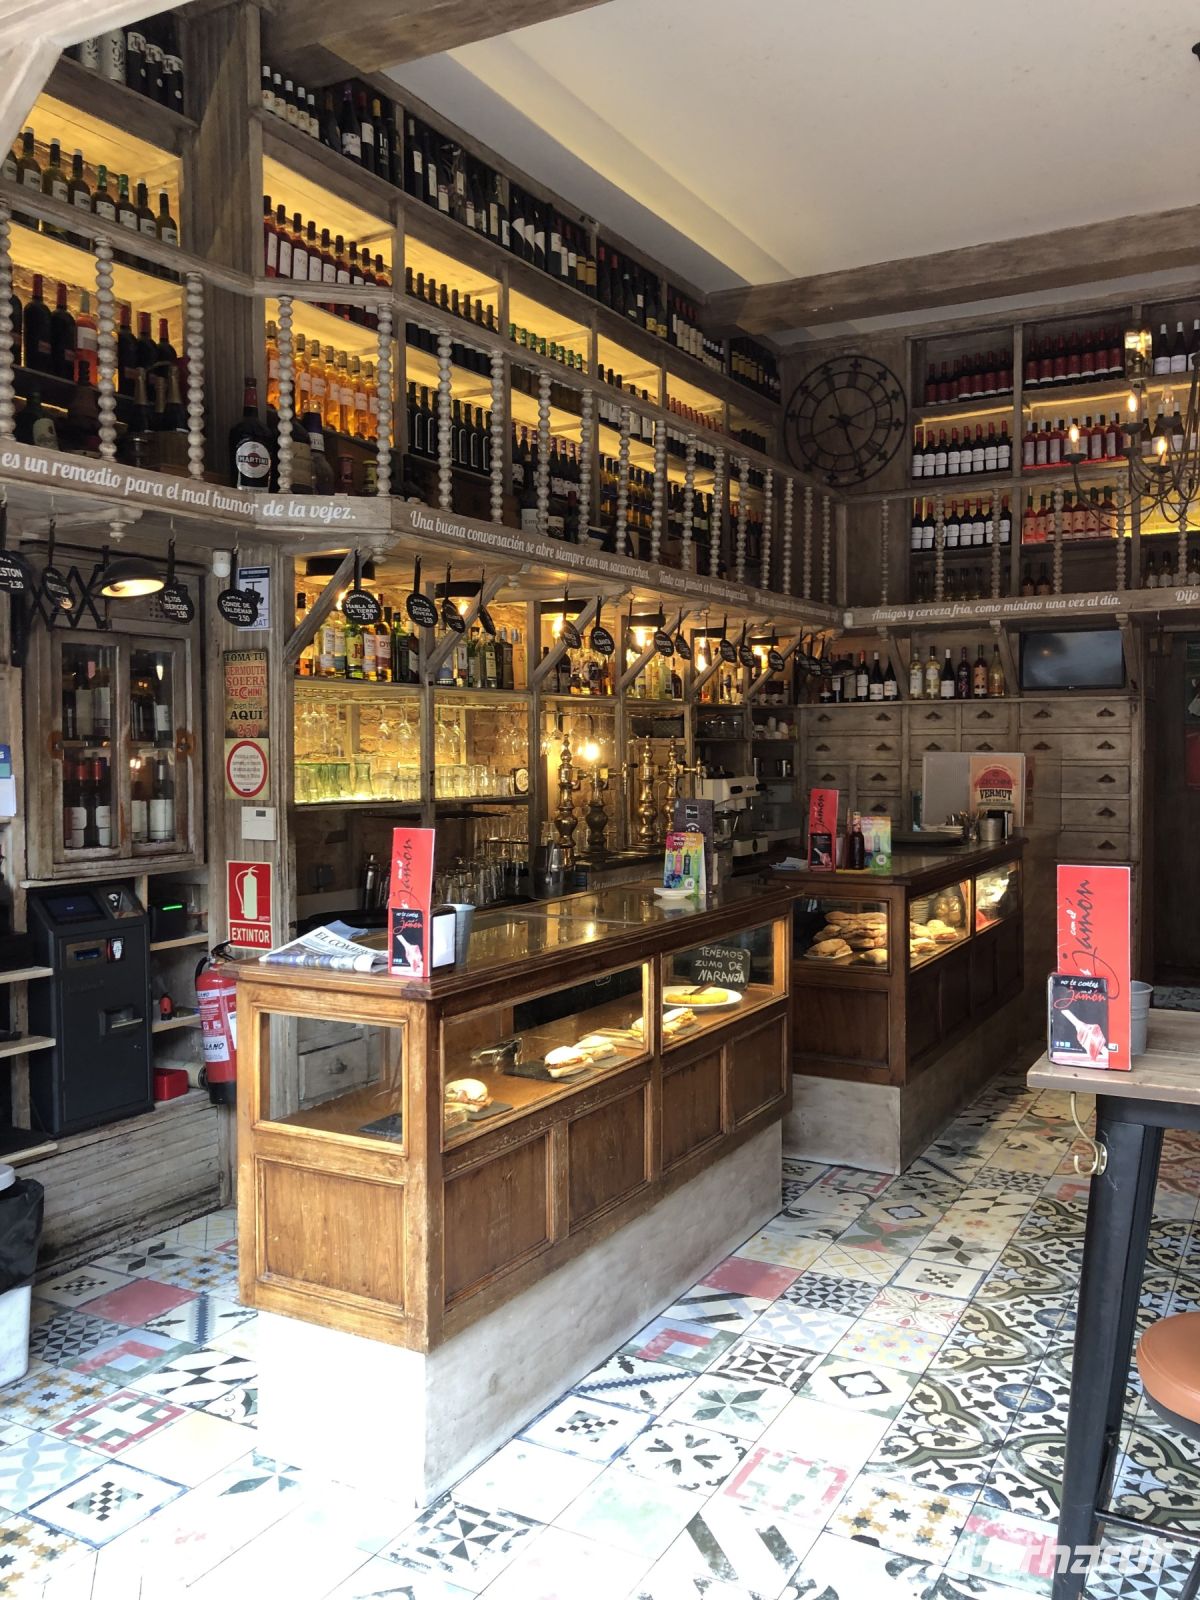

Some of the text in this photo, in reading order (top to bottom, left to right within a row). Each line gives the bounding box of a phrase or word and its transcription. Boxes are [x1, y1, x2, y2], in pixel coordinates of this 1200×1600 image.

[237, 455, 268, 465] MARTINI
[2, 452, 356, 523] es un remedio para el mal humor de la vejez.
[410, 511, 434, 528] Una
[436, 518, 466, 538] buena
[468, 528, 525, 552] conversación
[526, 542, 534, 553] se
[536, 543, 553, 558] abre
[555, 547, 584, 567] siempre
[586, 557, 598, 568] con
[1175, 590, 1199, 604] Dijo
[222, 600, 241, 608] CONDE
[872, 610, 906, 621] Amigos
[908, 610, 914, 620] y
[916, 607, 950, 617] cerveza
[951, 604, 973, 617] fría,
[975, 604, 1000, 613] como
[1045, 599, 1066, 609] una
[1068, 598, 1085, 608] vez
[1087, 596, 1098, 606] al
[1100, 595, 1121, 605] día.
[225, 653, 251, 661] TOMA
[226, 666, 266, 675] VERMOUTH
[226, 677, 265, 686] SOLERA
[230, 710, 263, 720] AQUI
[979, 788, 1012, 800] VERMUT
[231, 928, 270, 944] EXTINTOR
[314, 931, 329, 942] EL
[699, 946, 744, 960] TENEMOS
[694, 960, 742, 971] ZUMO DE
[697, 969, 745, 982] NARANJA
